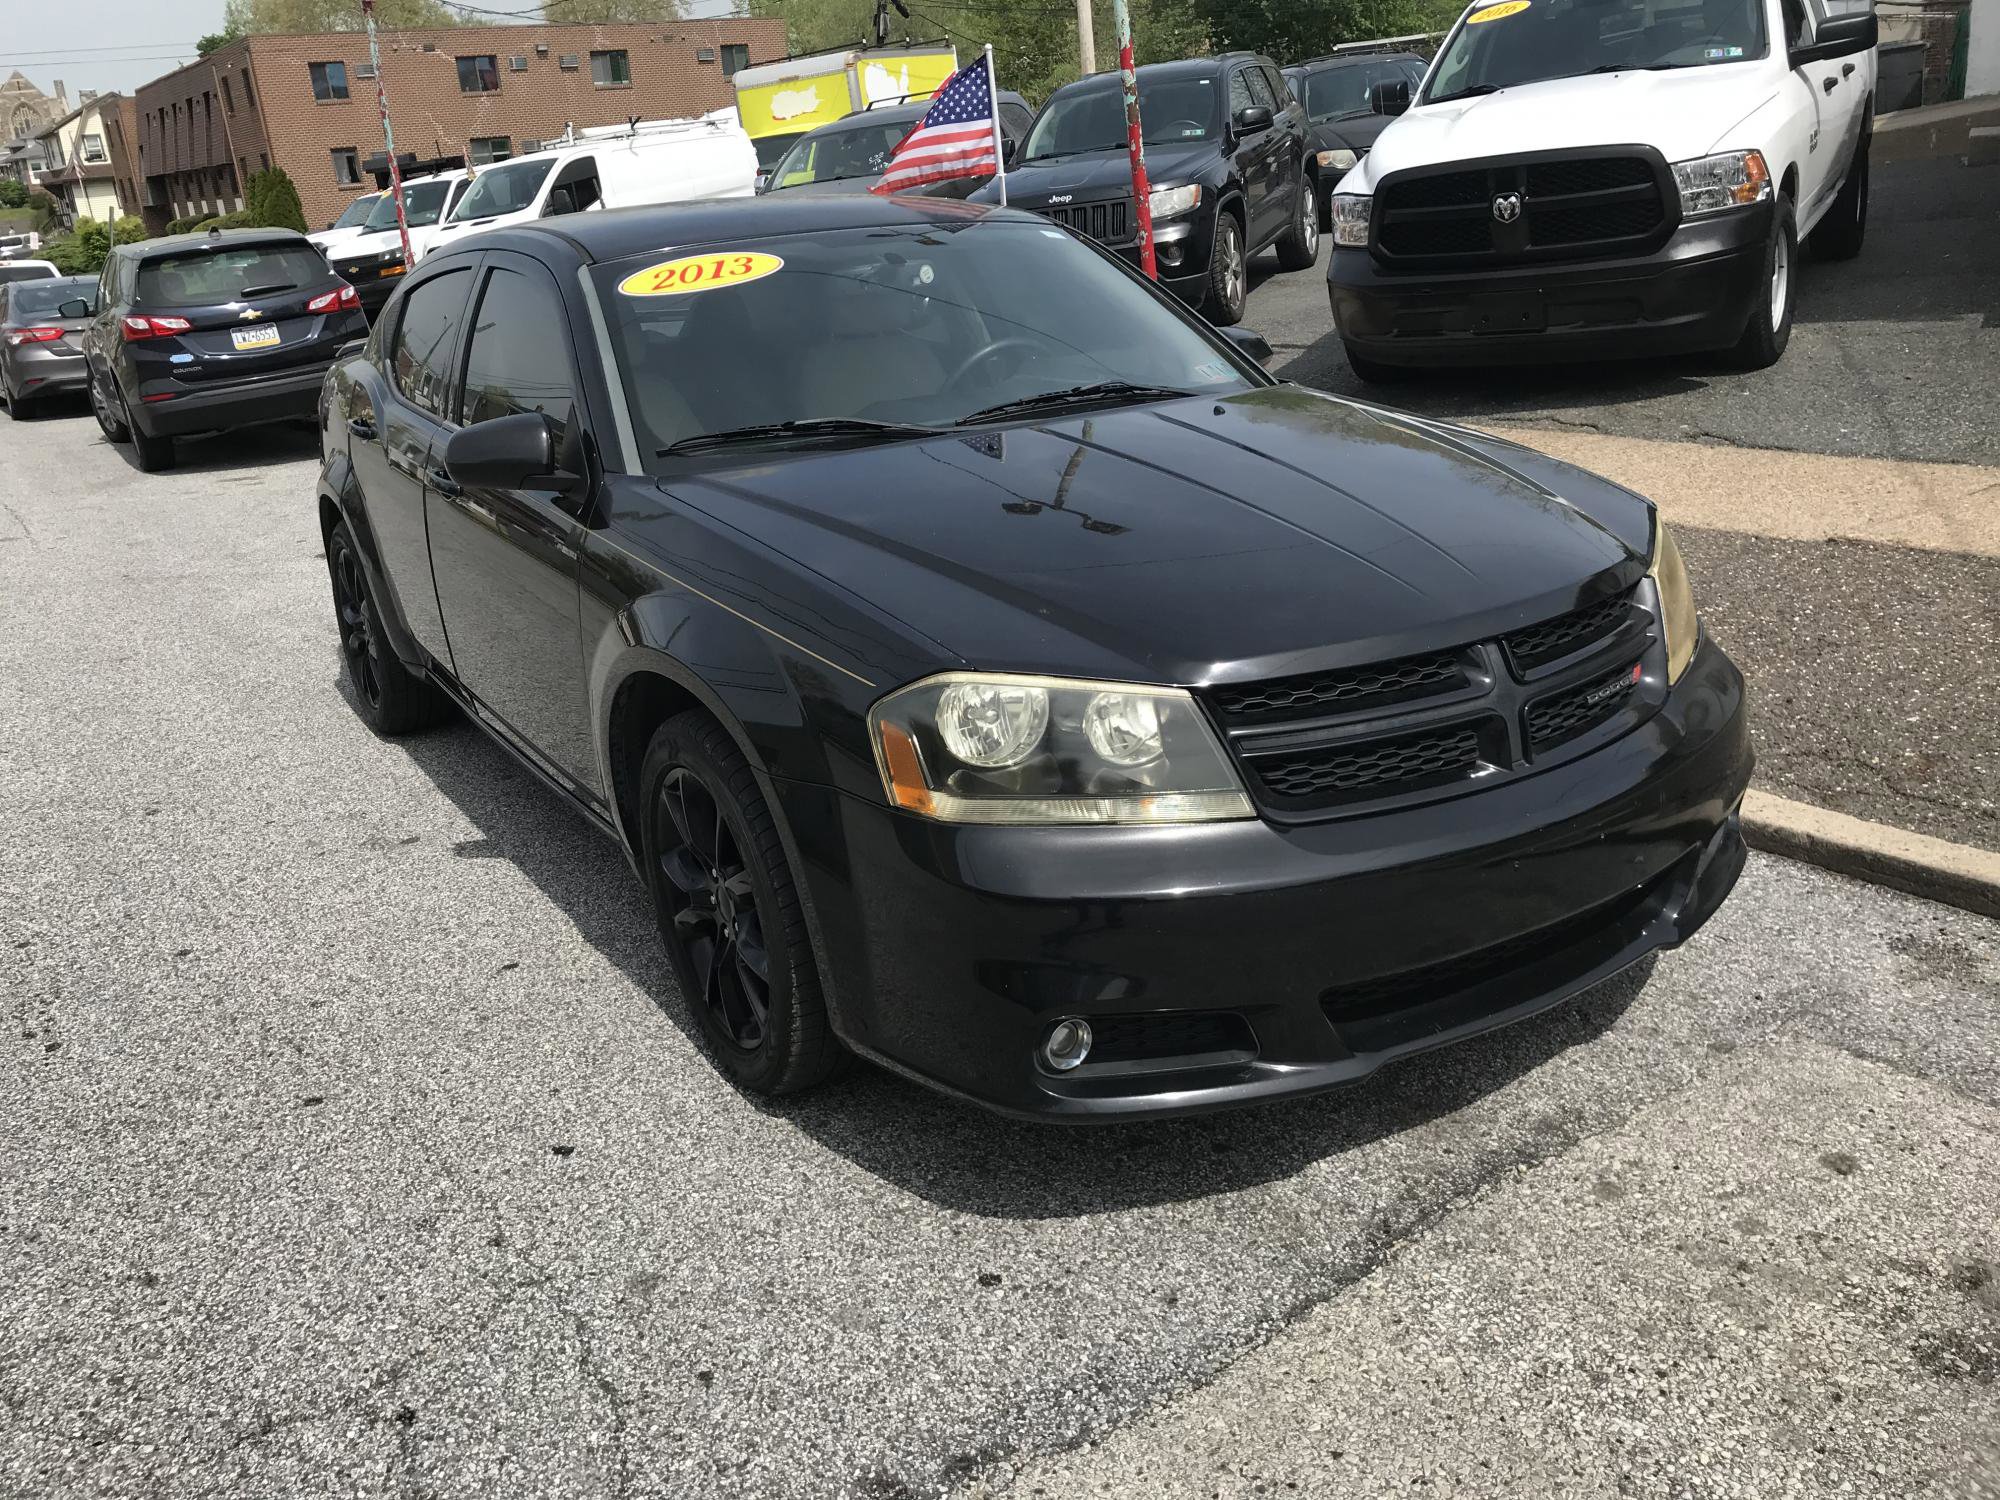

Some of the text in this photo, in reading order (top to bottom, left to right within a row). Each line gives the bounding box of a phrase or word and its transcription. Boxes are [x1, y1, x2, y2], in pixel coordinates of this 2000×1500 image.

[1476, 4, 1518, 20] 2016
[1049, 195, 1072, 203] Jeep
[651, 256, 753, 291] 2013
